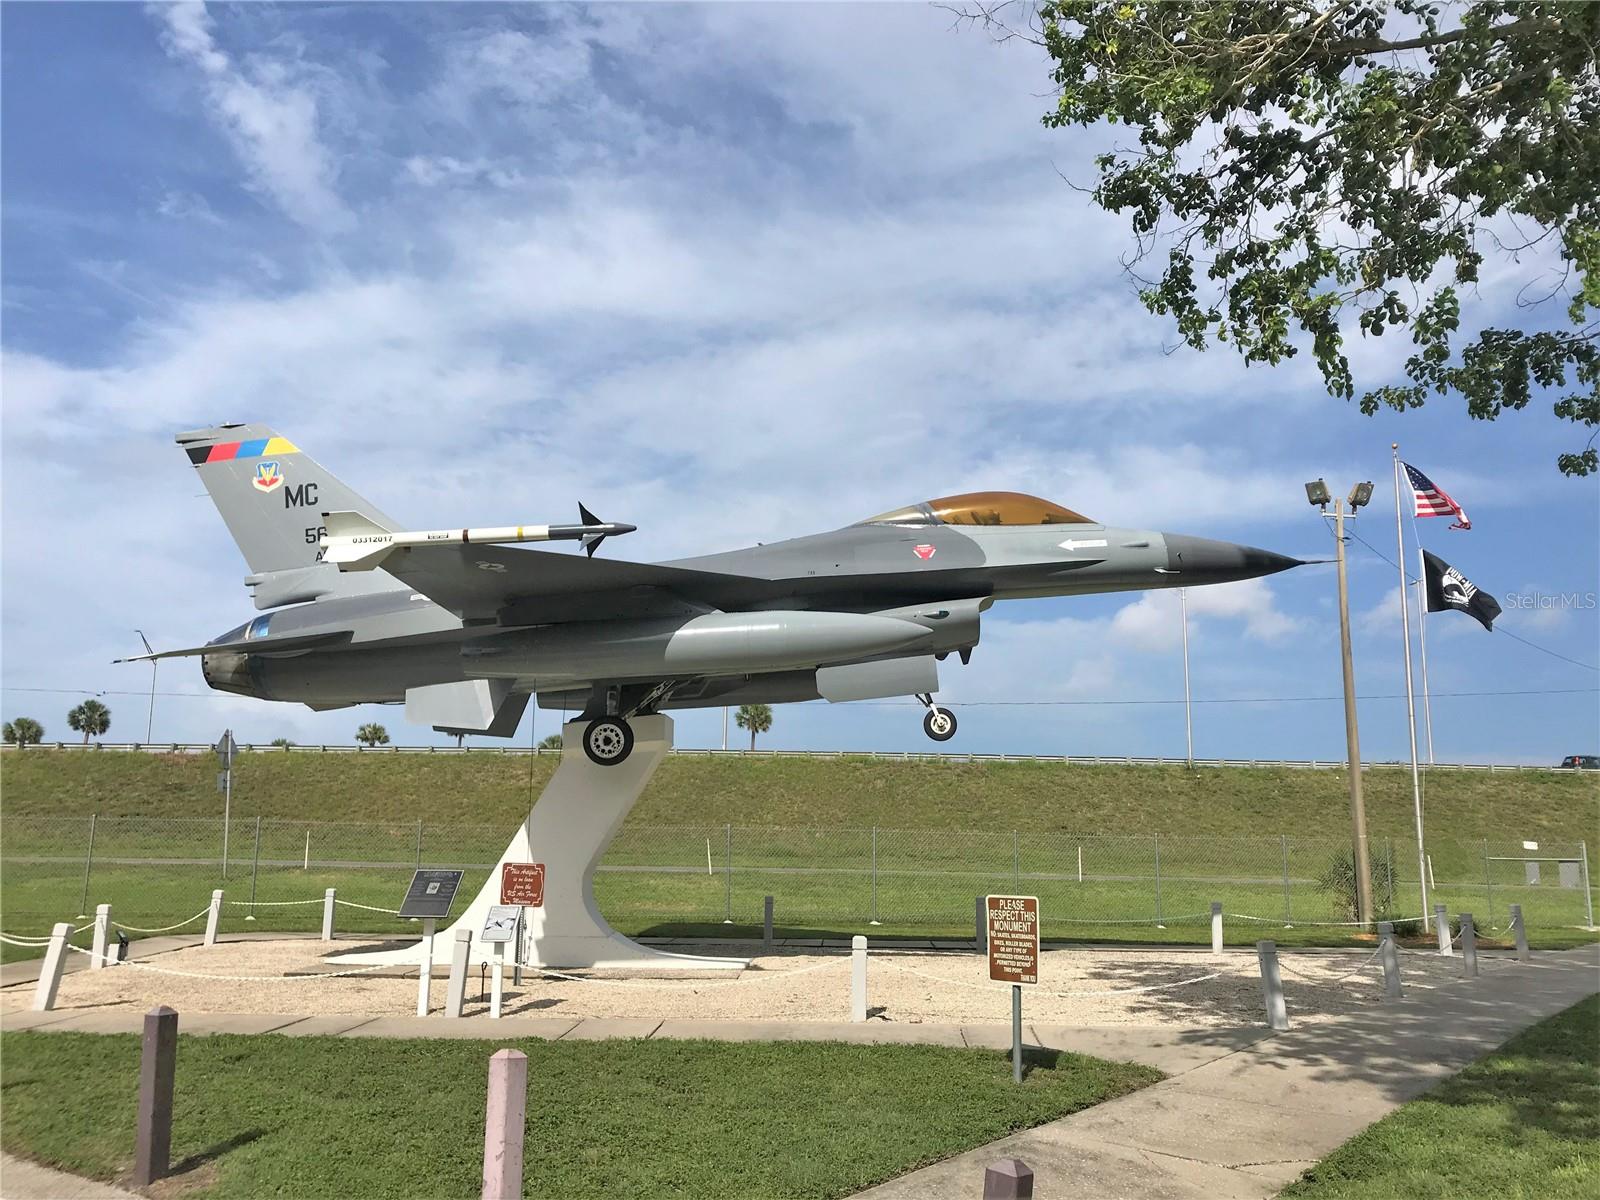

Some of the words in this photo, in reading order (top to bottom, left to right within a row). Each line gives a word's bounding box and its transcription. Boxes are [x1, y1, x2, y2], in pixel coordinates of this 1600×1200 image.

[284, 483, 318, 509] MC
[352, 535, 393, 544] 03312017
[999, 899, 1025, 911] PLEASE
[989, 909, 1018, 921] RESPECT
[1020, 911, 1036, 922] THIS
[993, 920, 1032, 932] MONUMENT
